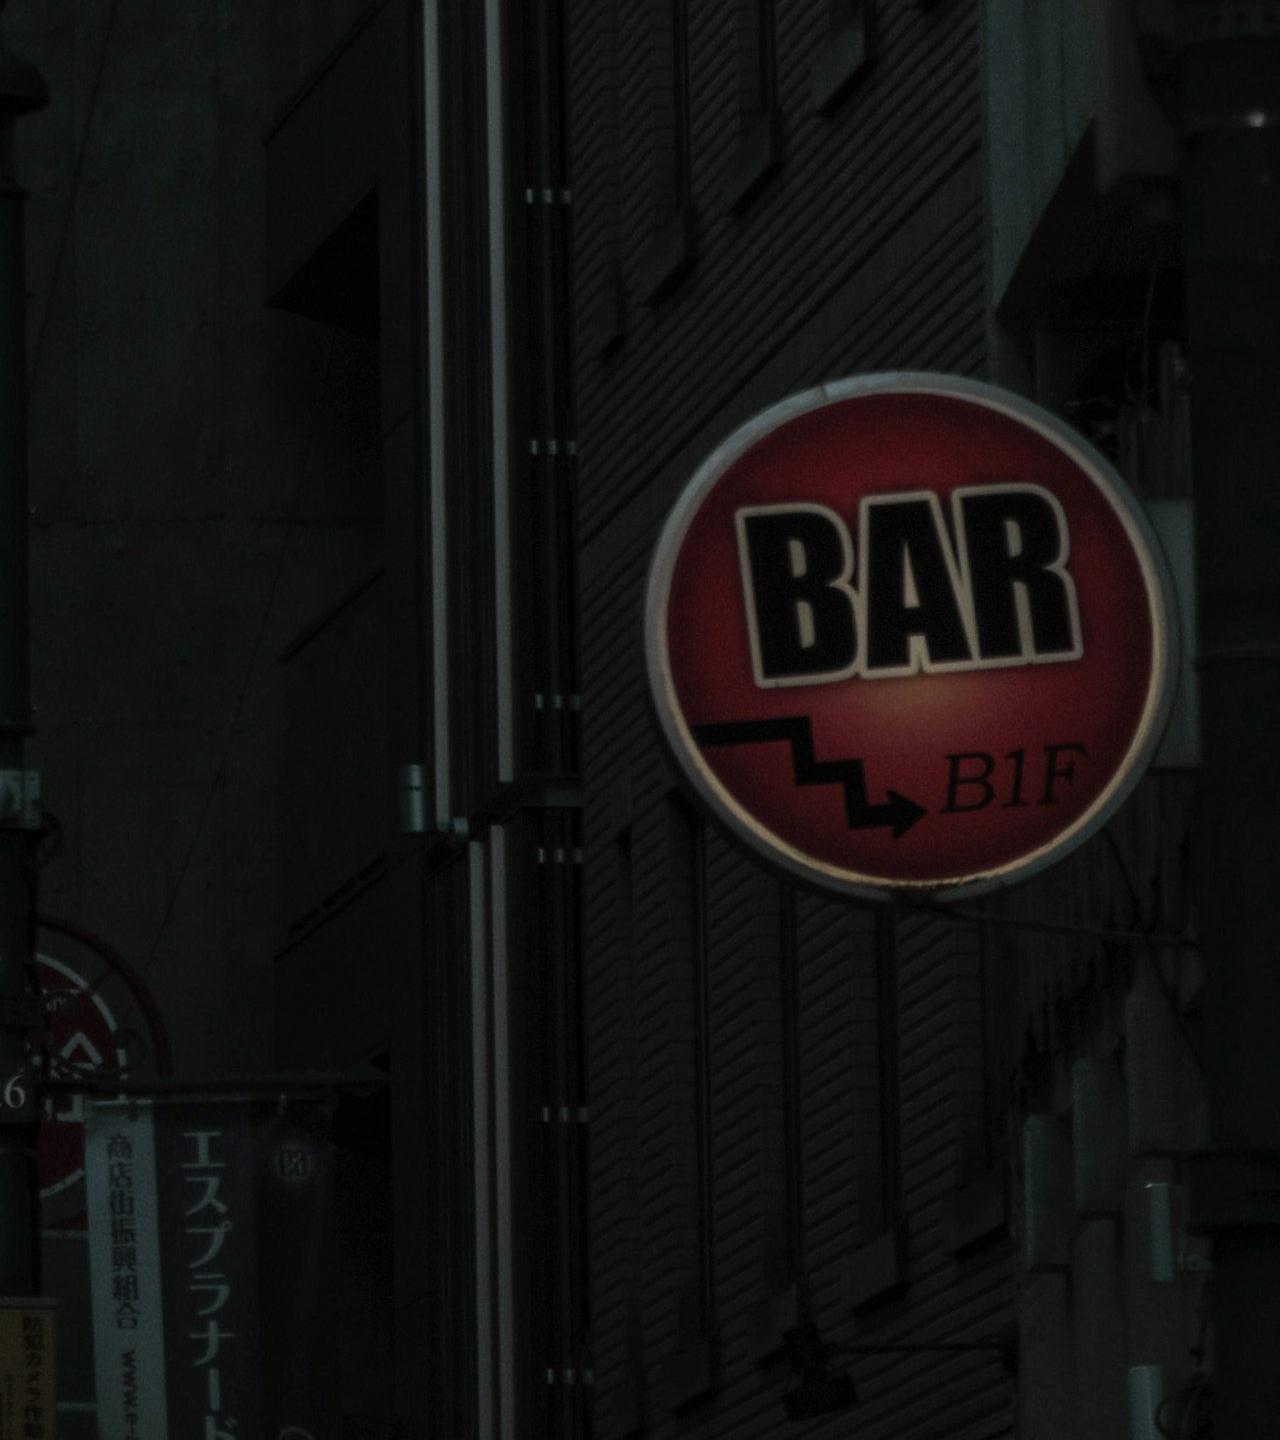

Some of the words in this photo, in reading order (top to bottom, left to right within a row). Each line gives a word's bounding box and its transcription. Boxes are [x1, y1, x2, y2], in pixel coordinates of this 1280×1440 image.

[734, 483, 1084, 689] BAR
[940, 743, 1089, 814] B1F
[107, 1132, 139, 1330] 商店街振興組合
